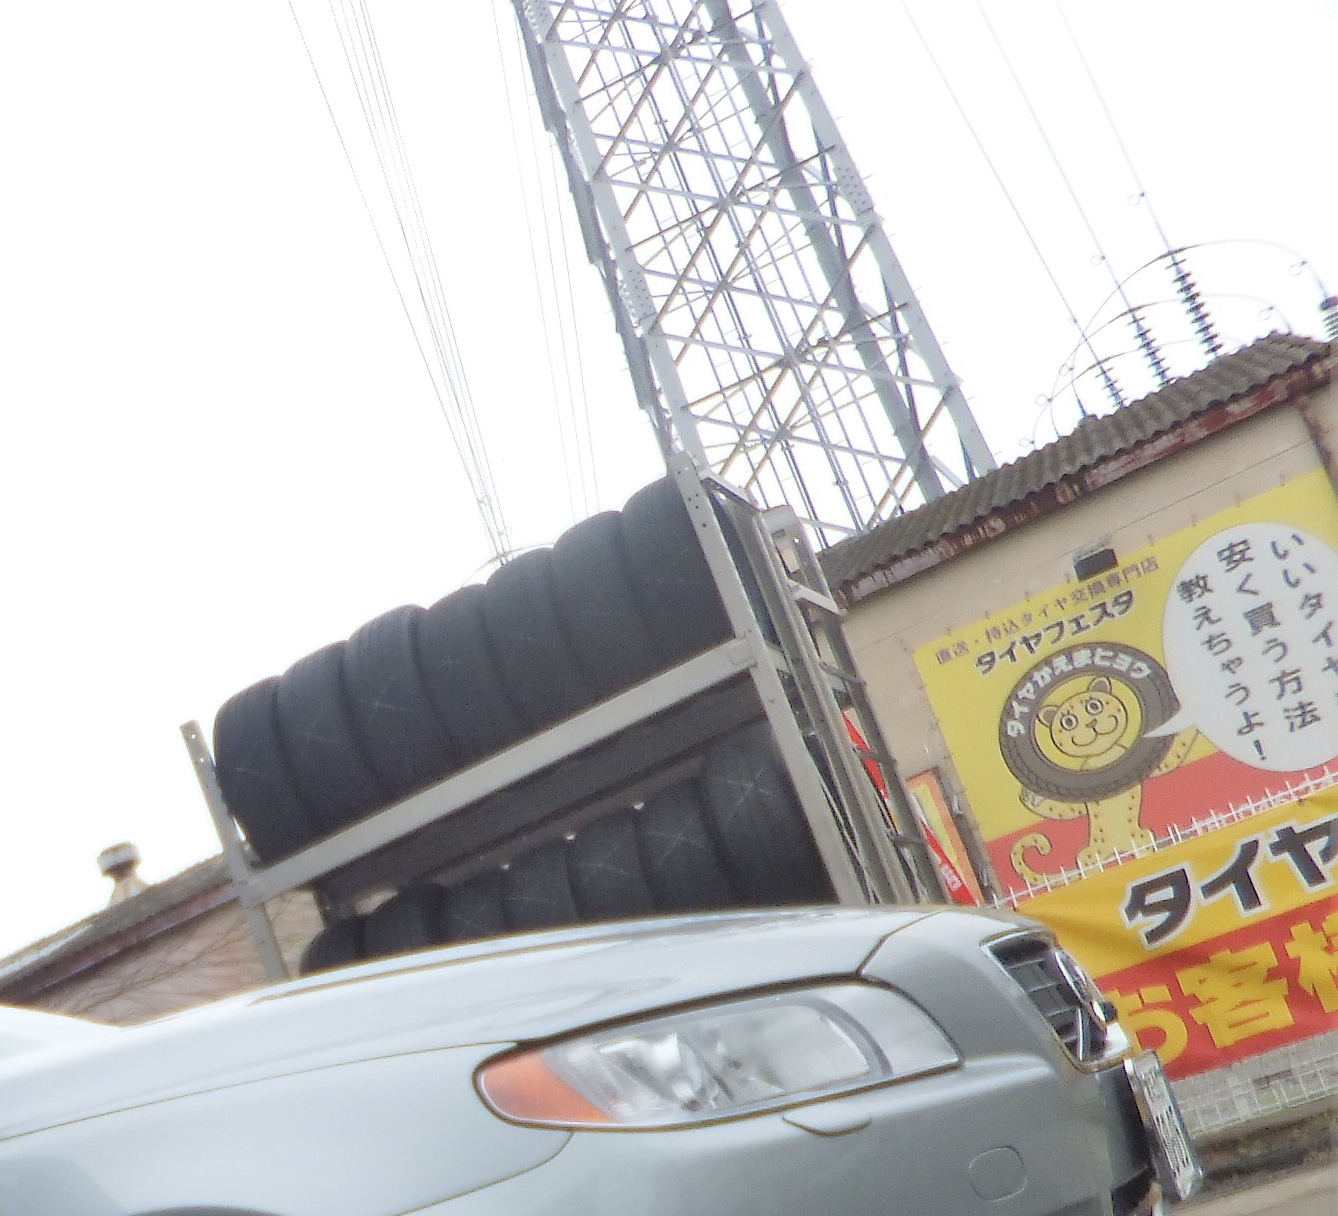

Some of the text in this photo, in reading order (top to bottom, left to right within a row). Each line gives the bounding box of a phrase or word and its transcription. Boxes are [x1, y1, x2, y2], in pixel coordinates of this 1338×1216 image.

[974, 589, 1137, 677] タイヤフェスタ
[1216, 538, 1322, 733] 安く買う方法
[1121, 813, 1338, 948] タイヤ
